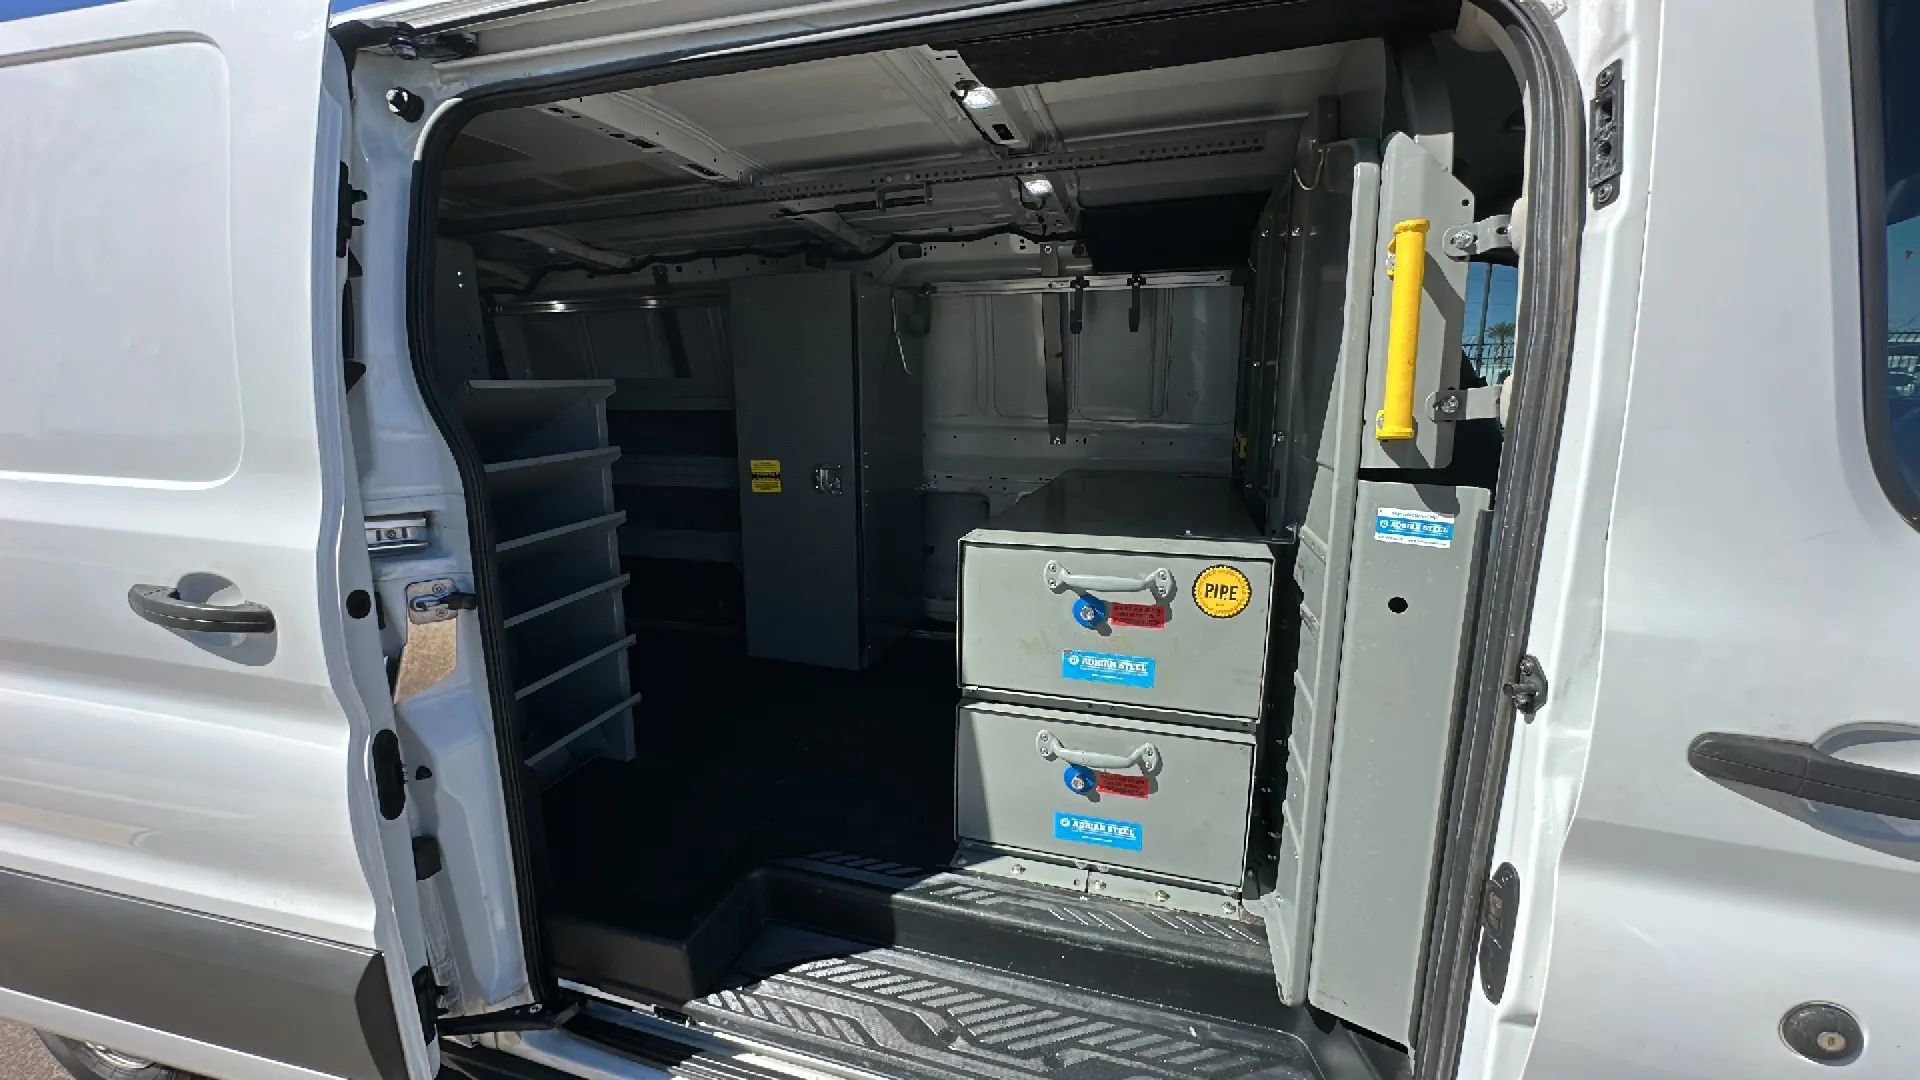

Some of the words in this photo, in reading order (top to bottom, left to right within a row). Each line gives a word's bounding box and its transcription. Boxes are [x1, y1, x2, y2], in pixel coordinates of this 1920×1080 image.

[1082, 657, 1116, 669] ADRIAN
[1118, 661, 1147, 672] STEEL
[1072, 820, 1106, 832] ADRIAN
[1107, 826, 1136, 837] STEEL
